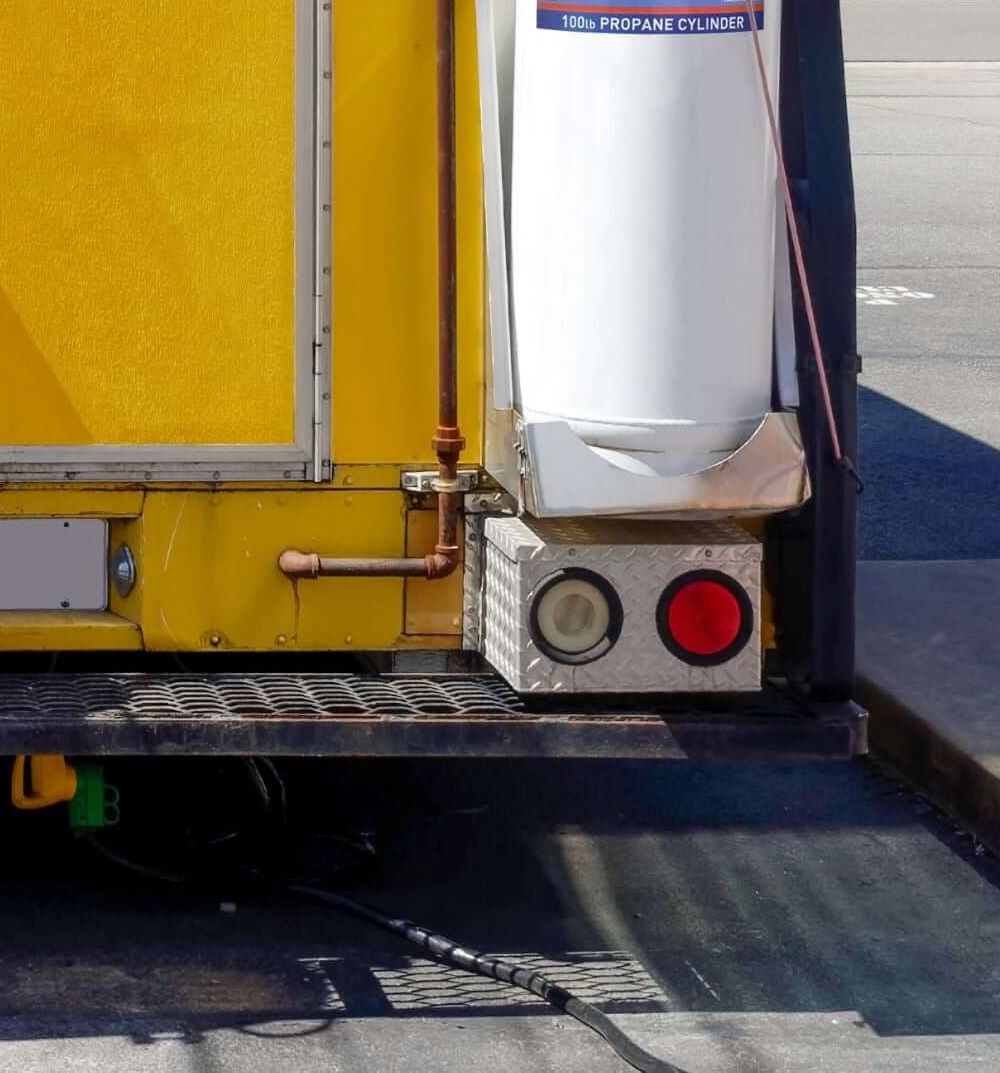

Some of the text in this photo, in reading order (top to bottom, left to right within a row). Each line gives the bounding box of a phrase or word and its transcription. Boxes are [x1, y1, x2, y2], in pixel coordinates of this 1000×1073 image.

[562, 15, 744, 31] 100lb PROPANE CYLINDER
